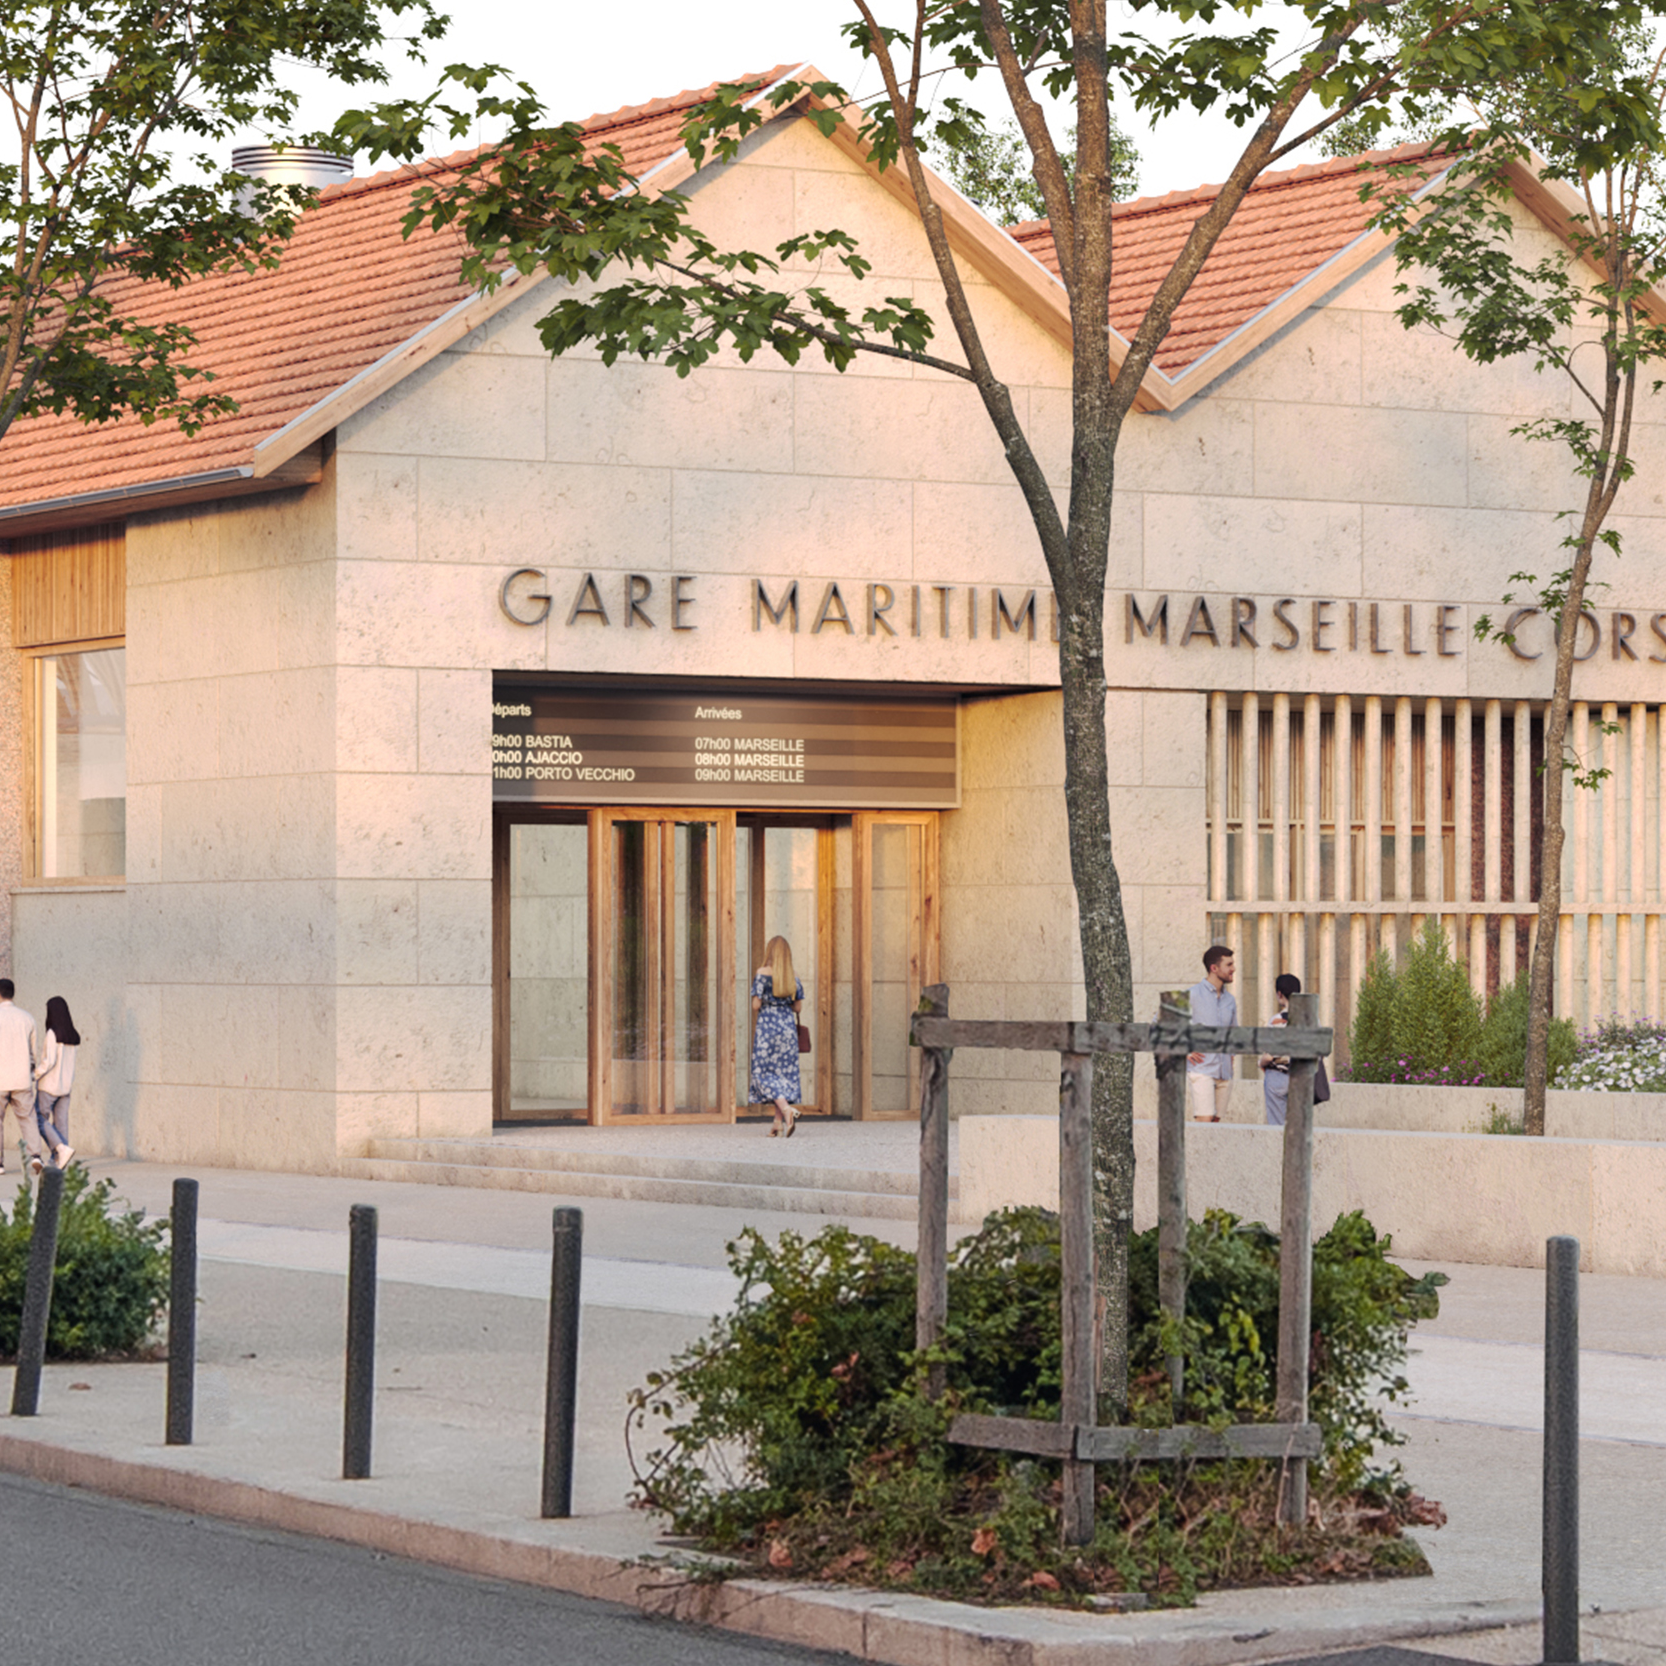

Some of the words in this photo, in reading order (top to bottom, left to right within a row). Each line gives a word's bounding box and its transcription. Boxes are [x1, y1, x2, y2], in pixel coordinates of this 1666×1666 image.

[498, 568, 697, 630] GARE
[1124, 593, 1462, 655] MARSEILLE
[492, 702, 532, 718] éparts
[695, 706, 742, 720] Arrivées
[492, 734, 522, 748] 9h00
[525, 735, 573, 748] BASTIA
[695, 737, 731, 750] 07h00
[734, 738, 804, 752] MARSEILLE
[492, 750, 522, 763] 0h00
[525, 751, 583, 765] AJACCIO
[695, 752, 731, 766] 08h00
[734, 753, 804, 767] MARSEILLE
[493, 766, 522, 780] 1h00
[525, 767, 572, 780] PORTO
[575, 768, 635, 781] VECCHIO
[695, 768, 731, 781] 09h00
[734, 769, 804, 783] MARSEILLE
